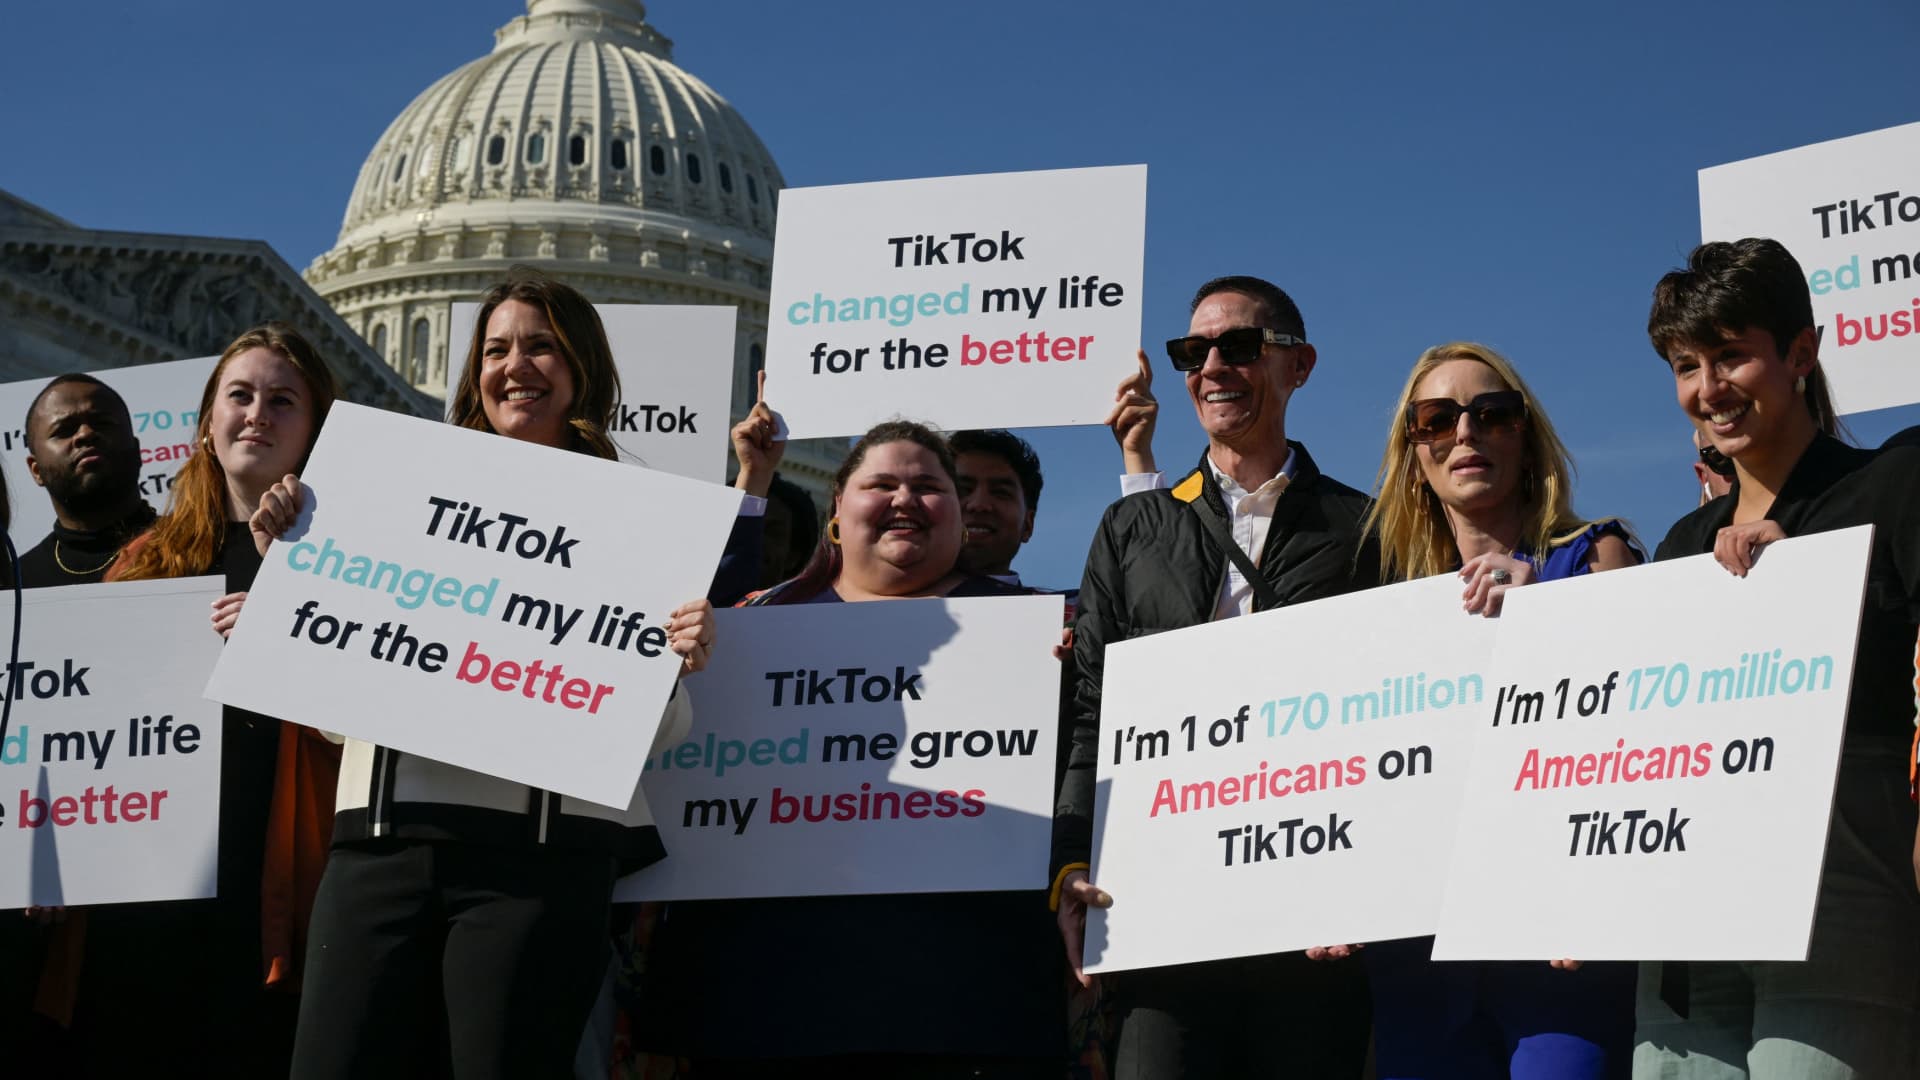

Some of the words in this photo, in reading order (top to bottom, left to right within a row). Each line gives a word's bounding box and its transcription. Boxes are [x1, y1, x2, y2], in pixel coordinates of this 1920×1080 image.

[1812, 191, 1920, 239] TikTo
[888, 231, 1025, 268] TikTok
[1872, 253, 1920, 284] m
[787, 283, 970, 327] changed
[981, 286, 1047, 319] my
[1058, 276, 1124, 309] life
[1836, 297, 1920, 347] busi
[810, 342, 869, 374] for
[881, 338, 949, 371] the
[960, 331, 1094, 366] better
[133, 410, 173, 433] 70
[426, 496, 580, 568] TikTok
[287, 538, 499, 616] changed
[502, 592, 584, 645] my
[588, 604, 668, 657] life
[290, 600, 363, 651] for
[370, 622, 448, 673] the
[456, 641, 614, 715] better
[765, 667, 922, 707] TikTok
[1492, 684, 1544, 727] I'm
[1555, 678, 1570, 720] 1
[1577, 671, 1619, 717] of
[1625, 662, 1689, 712] 170
[1697, 648, 1834, 704] million
[42, 729, 116, 770] my
[128, 715, 201, 757] life
[1113, 725, 1169, 765] I'm
[1181, 716, 1196, 751] 1
[1208, 705, 1250, 747] of
[1259, 692, 1329, 738] 170
[1341, 671, 1483, 725] million
[822, 733, 897, 763] me
[910, 729, 1038, 770] grow
[1513, 738, 1713, 791] Americans
[1722, 737, 1774, 774] on
[1150, 755, 1366, 817] Americans
[1378, 744, 1432, 780] on
[18, 785, 168, 829] better
[682, 797, 758, 835] my
[769, 783, 986, 825] business
[1568, 808, 1690, 857] TikTok
[1217, 813, 1353, 867] TikTok
